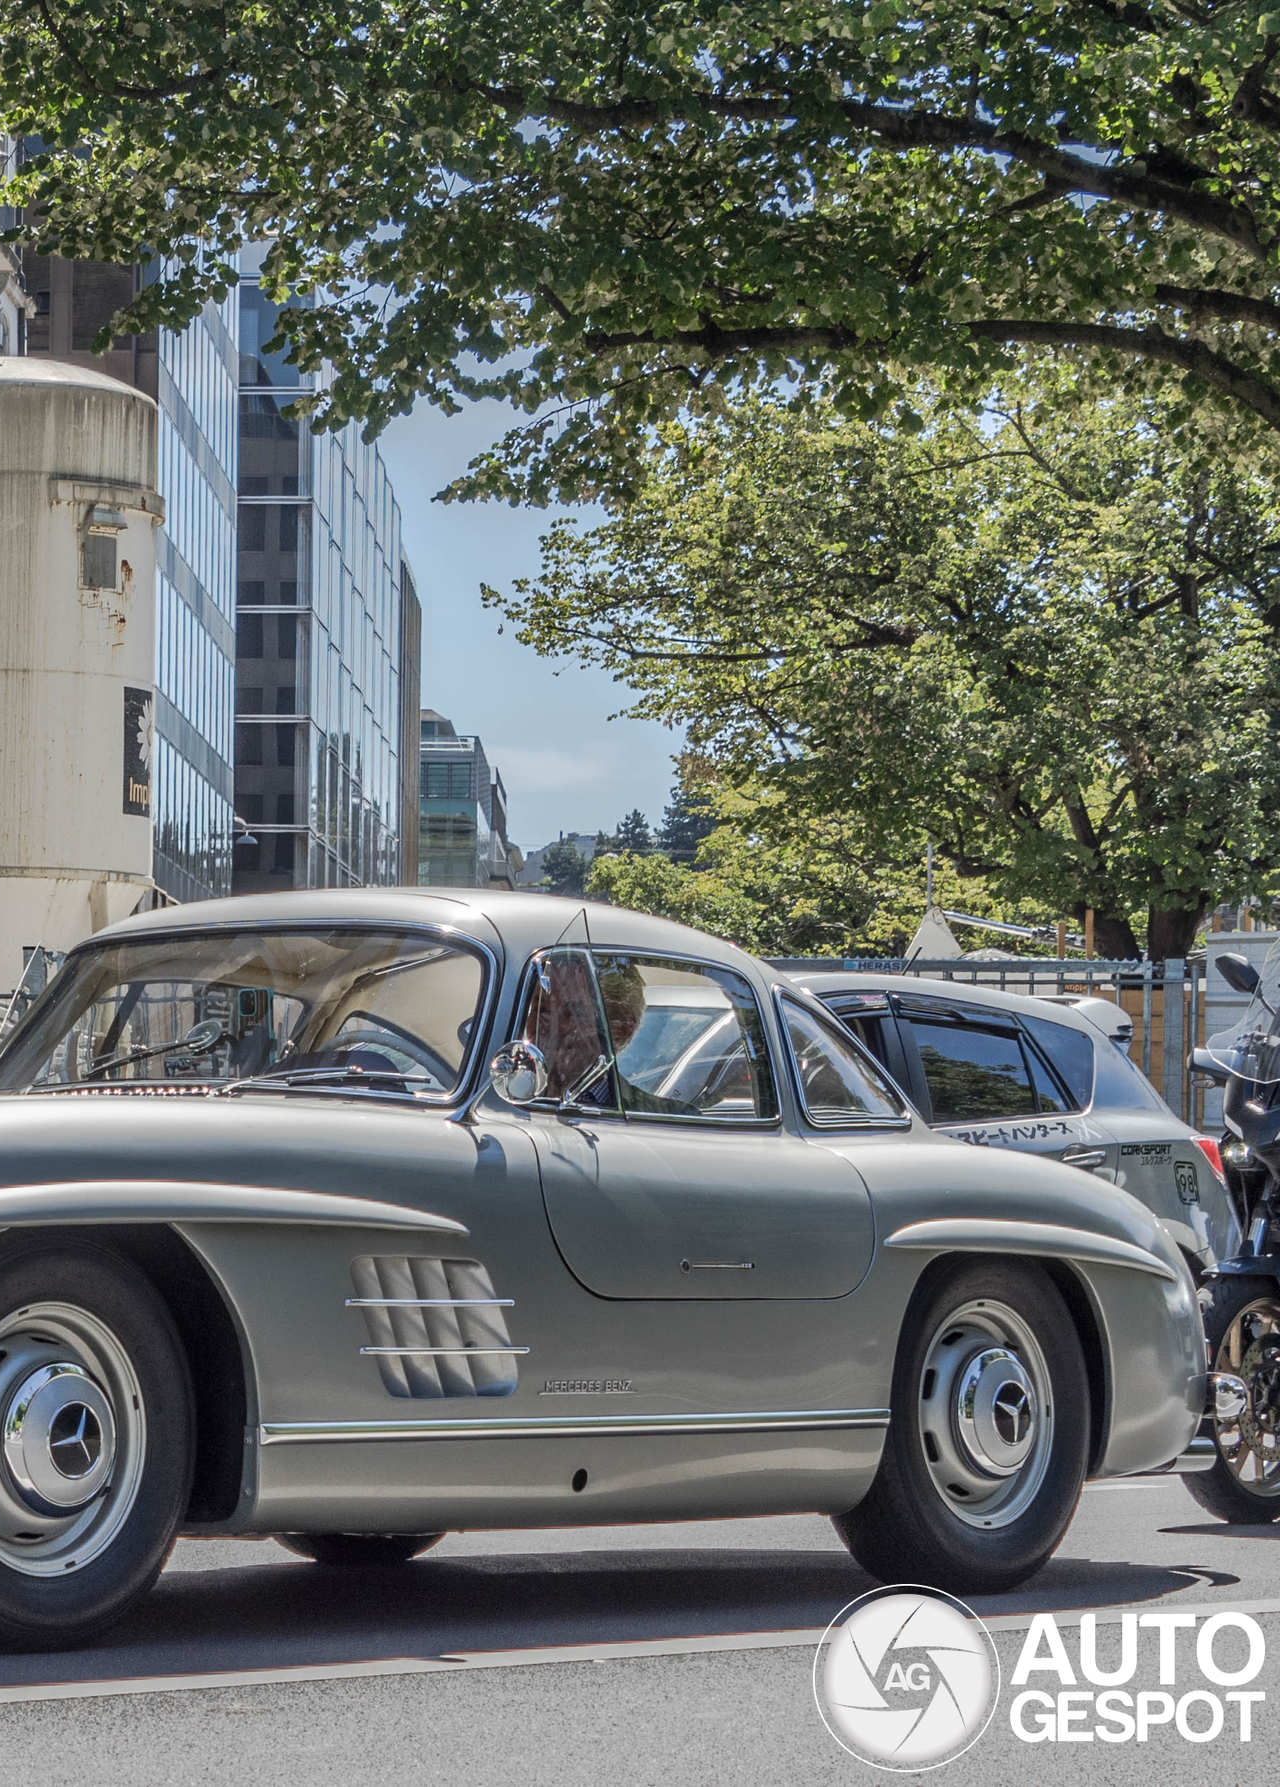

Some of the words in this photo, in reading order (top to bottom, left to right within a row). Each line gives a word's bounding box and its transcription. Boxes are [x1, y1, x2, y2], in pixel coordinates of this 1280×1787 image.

[858, 961, 901, 970] HERAS
[1121, 1144, 1172, 1155] CORKSPORT
[1179, 1174, 1195, 1193] 98
[545, 1380, 601, 1392] MERCEDES
[605, 1380, 632, 1391] BENZ
